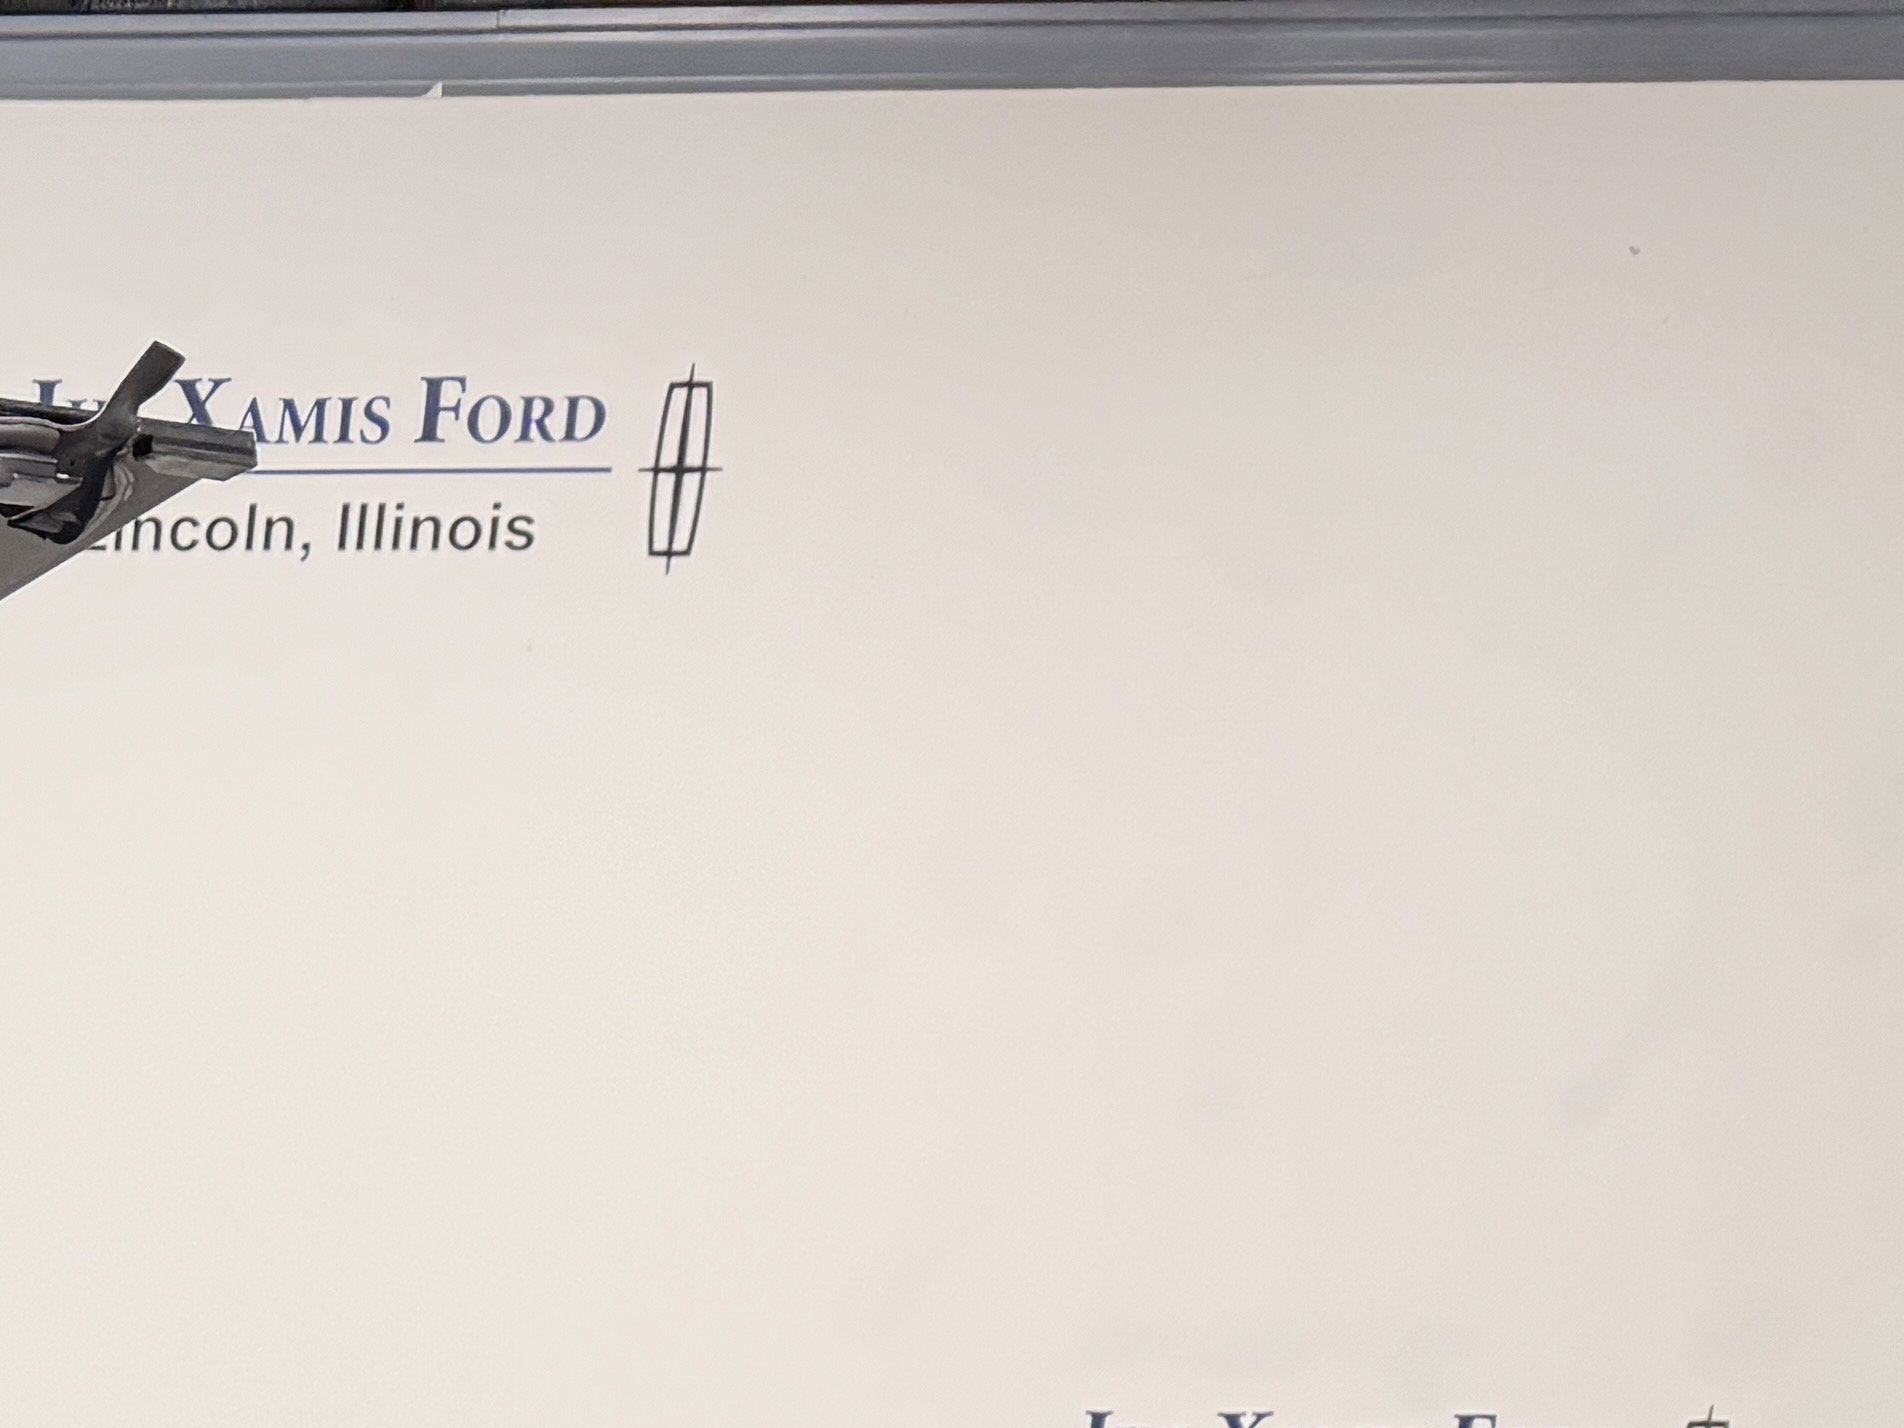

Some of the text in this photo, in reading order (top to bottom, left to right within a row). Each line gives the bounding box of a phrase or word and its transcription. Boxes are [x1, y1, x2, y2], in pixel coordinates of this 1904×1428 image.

[414, 374, 608, 446] FORD
[88, 502, 537, 561] incoln, Illinois
